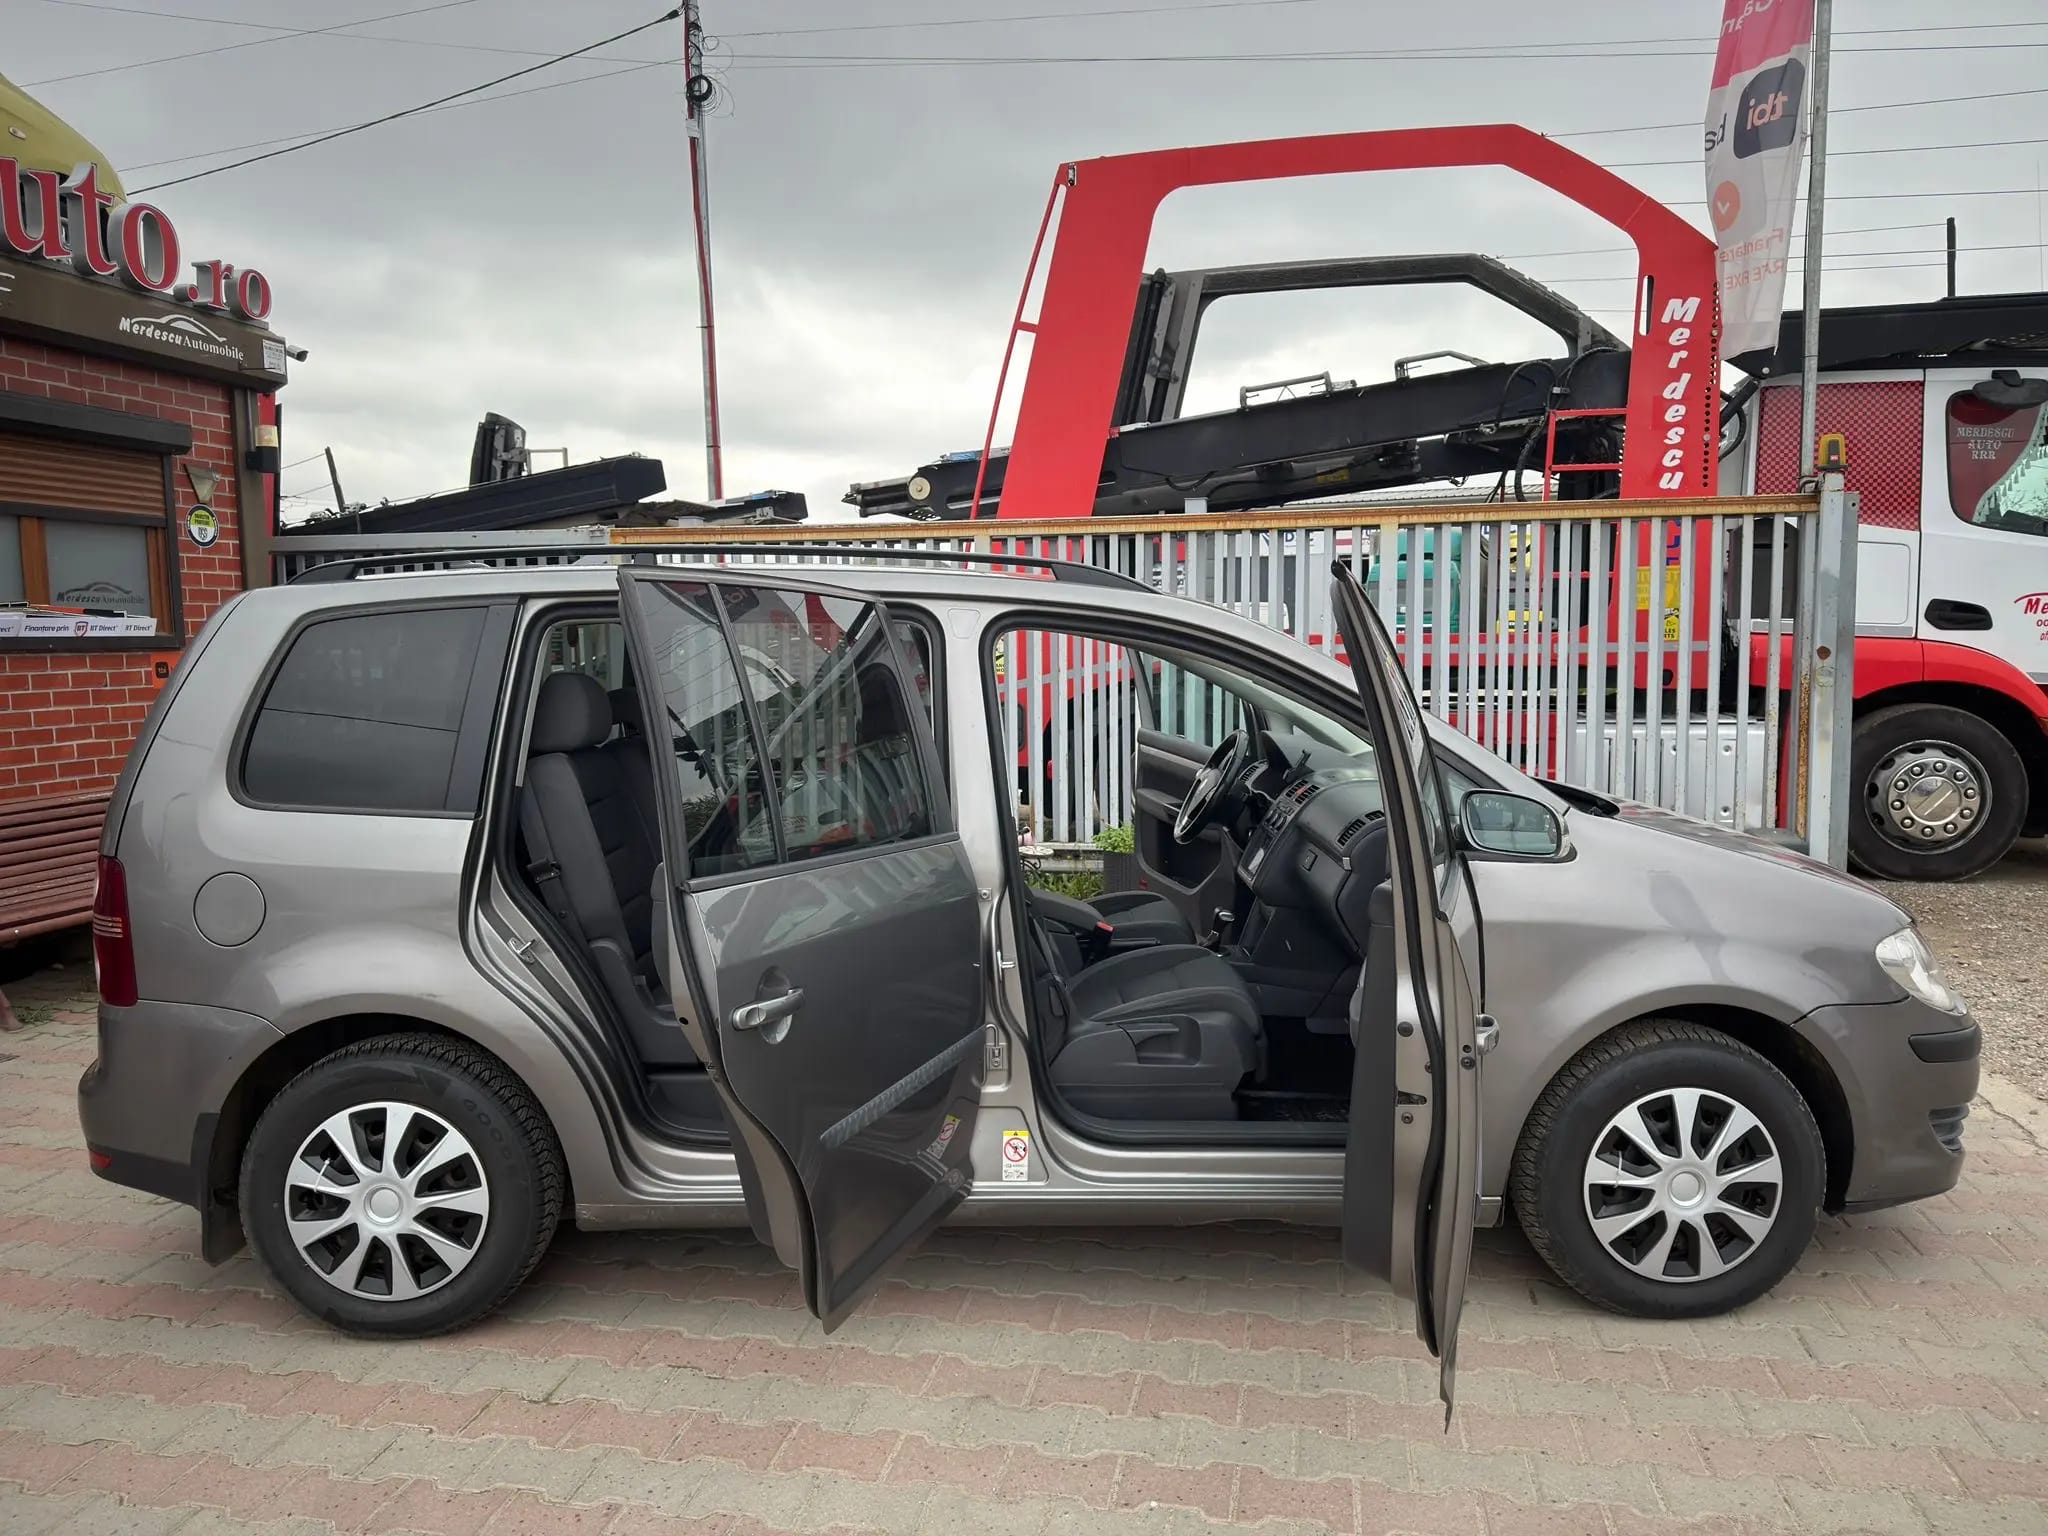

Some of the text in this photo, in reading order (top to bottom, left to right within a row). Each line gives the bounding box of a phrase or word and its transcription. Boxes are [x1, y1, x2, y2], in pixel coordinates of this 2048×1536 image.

[119, 316, 182, 346] Merdescu
[182, 335, 245, 361] Automobile
[1659, 296, 1702, 490] Merdescu
[1968, 440, 2001, 450] AUTO
[1971, 450, 1996, 460] RRR
